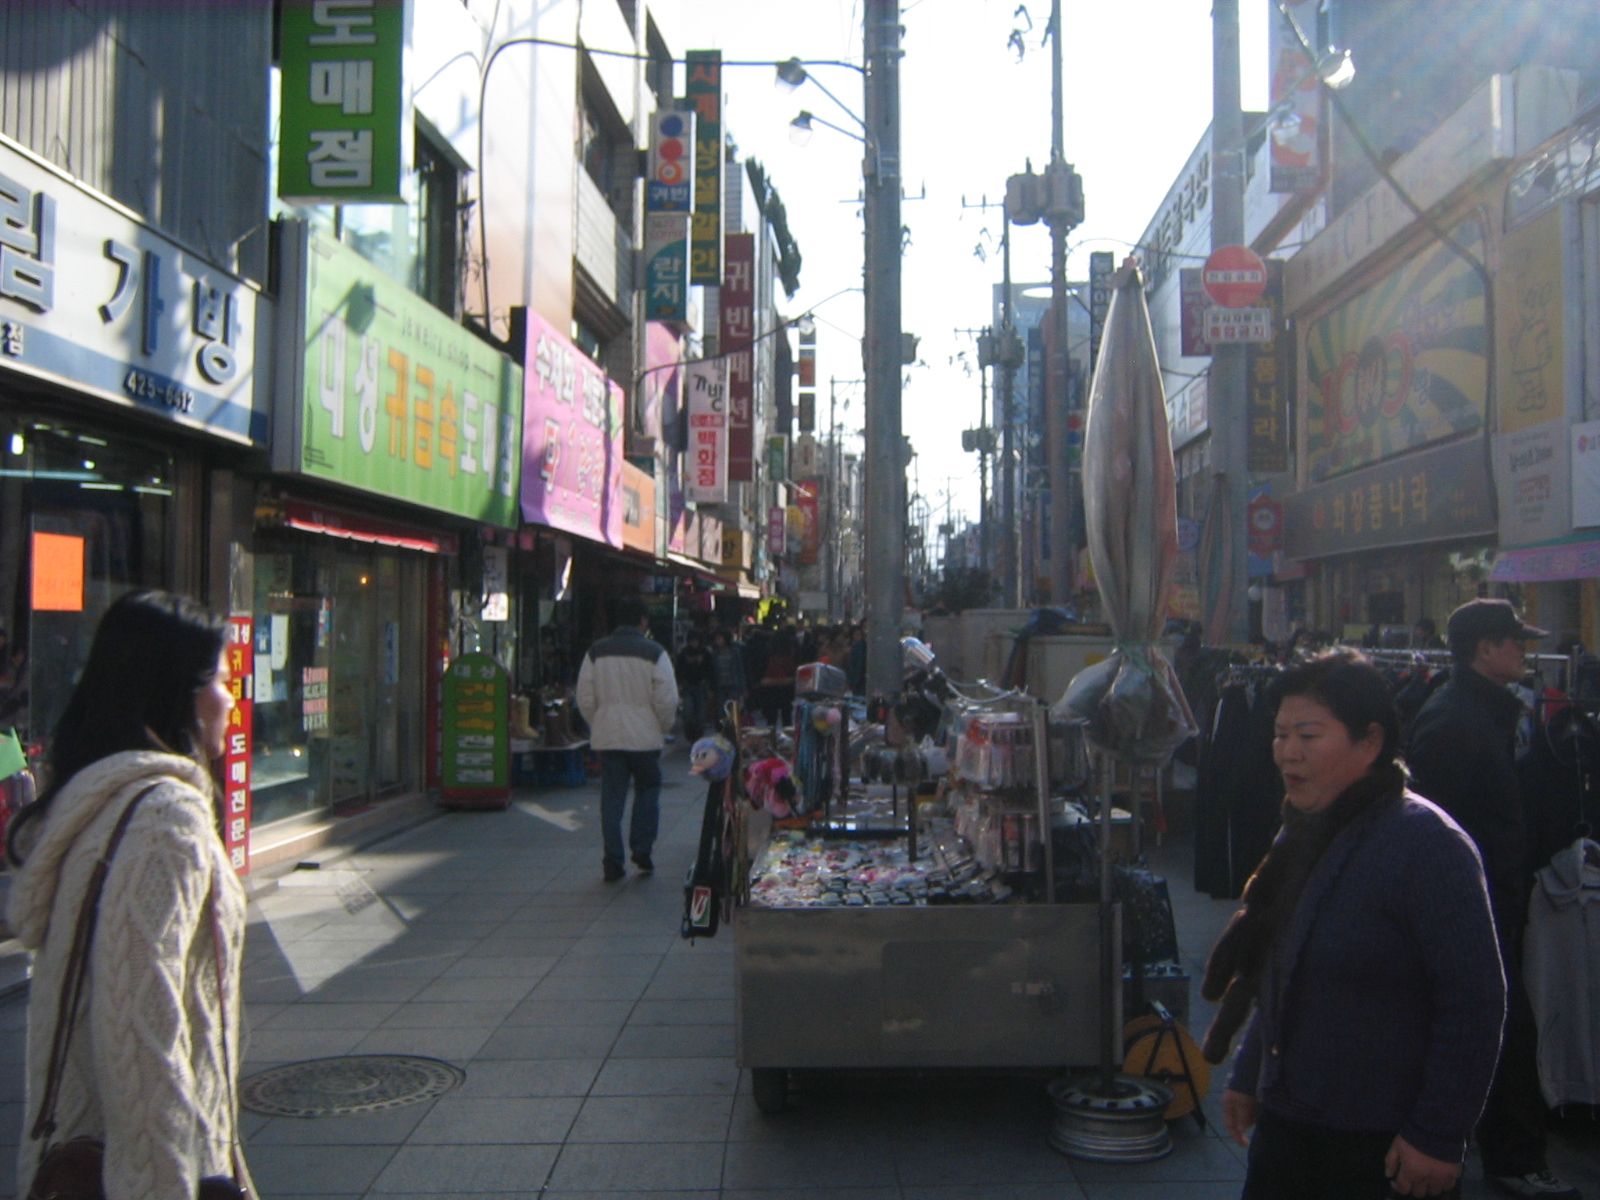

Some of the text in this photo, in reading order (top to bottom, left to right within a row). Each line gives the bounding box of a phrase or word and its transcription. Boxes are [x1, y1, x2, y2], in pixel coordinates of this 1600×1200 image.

[308, 0, 376, 187] 도매점
[98, 239, 241, 385] 가방
[693, 374, 723, 412] 가방
[697, 431, 717, 487] 백화점
